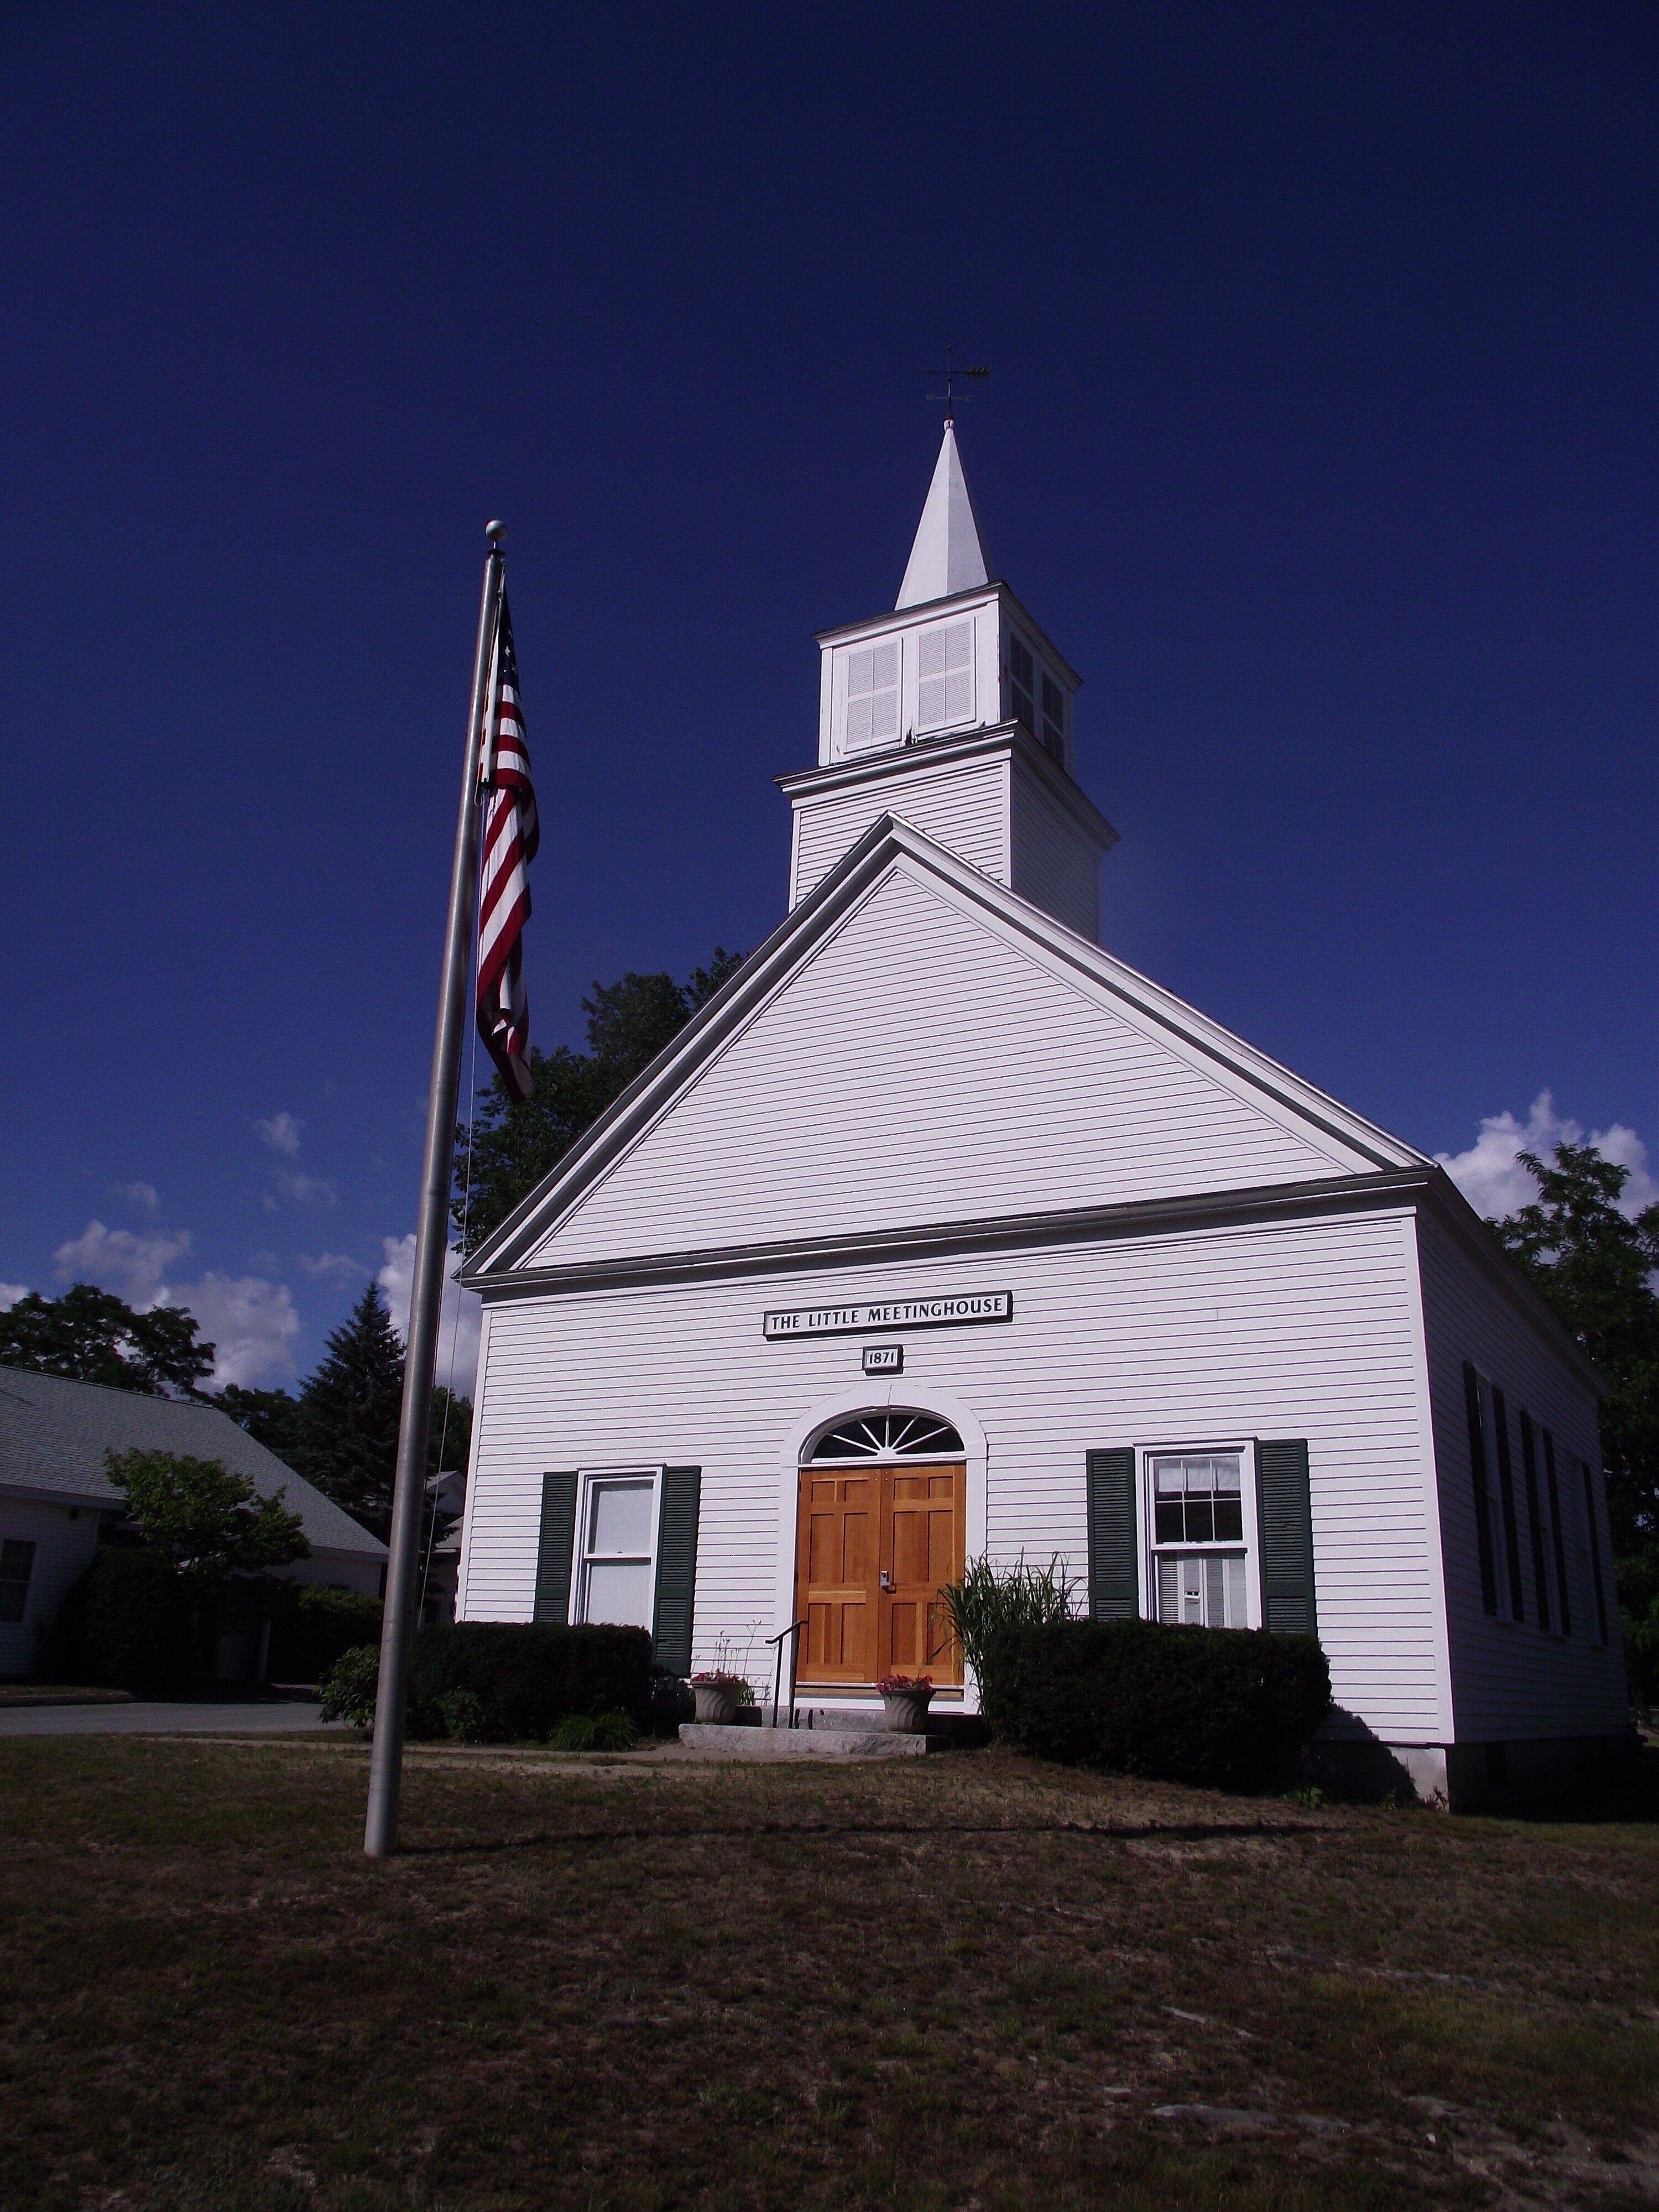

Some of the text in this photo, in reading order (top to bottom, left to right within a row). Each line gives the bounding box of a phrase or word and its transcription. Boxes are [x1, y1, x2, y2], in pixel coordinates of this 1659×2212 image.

[771, 1298, 1003, 1329] THE LITTLE MEETINGHOUSE
[869, 1352, 894, 1364] 1871
